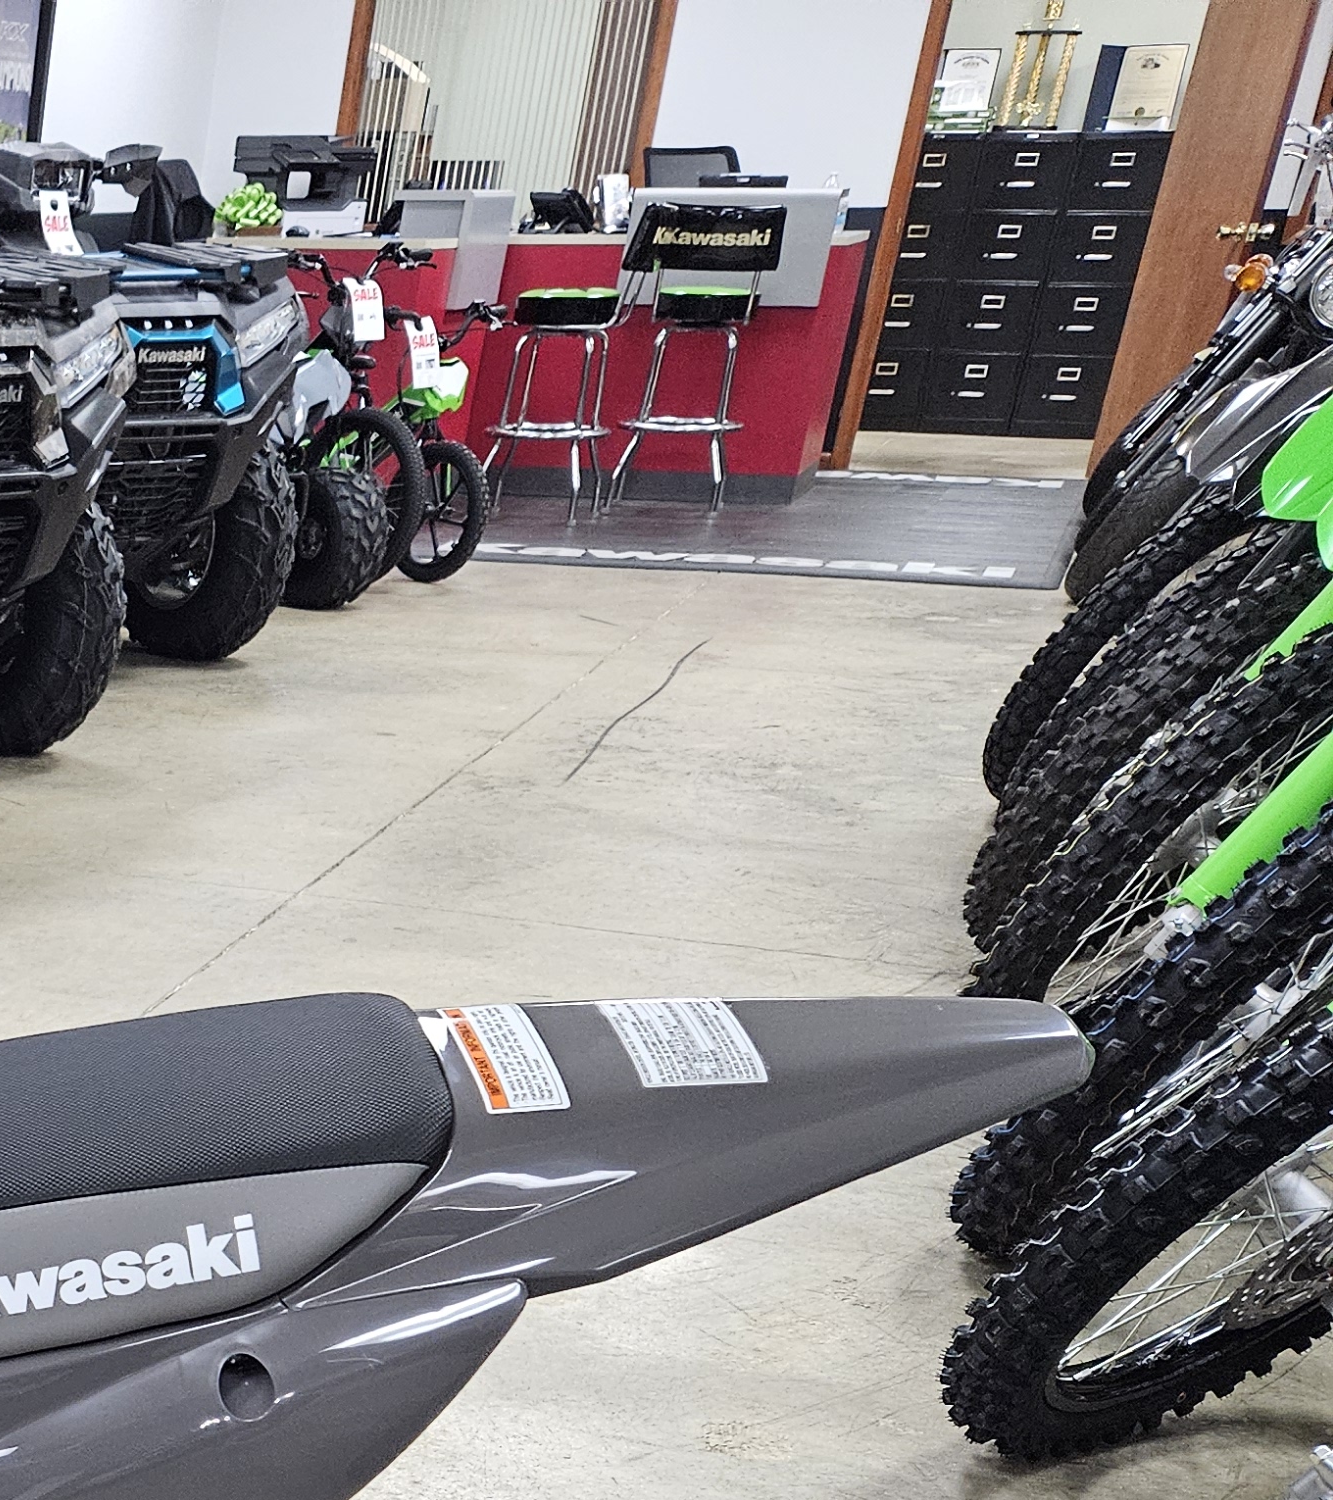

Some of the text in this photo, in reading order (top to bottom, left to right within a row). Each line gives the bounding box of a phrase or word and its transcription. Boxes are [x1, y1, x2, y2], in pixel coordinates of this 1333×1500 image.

[44, 215, 70, 233] SALE
[663, 227, 772, 247] Kawasaki
[353, 287, 379, 302] SALE
[412, 333, 435, 350] SALE
[138, 345, 206, 366] Kawasaki
[471, 1056, 503, 1096] IMPORTANT
